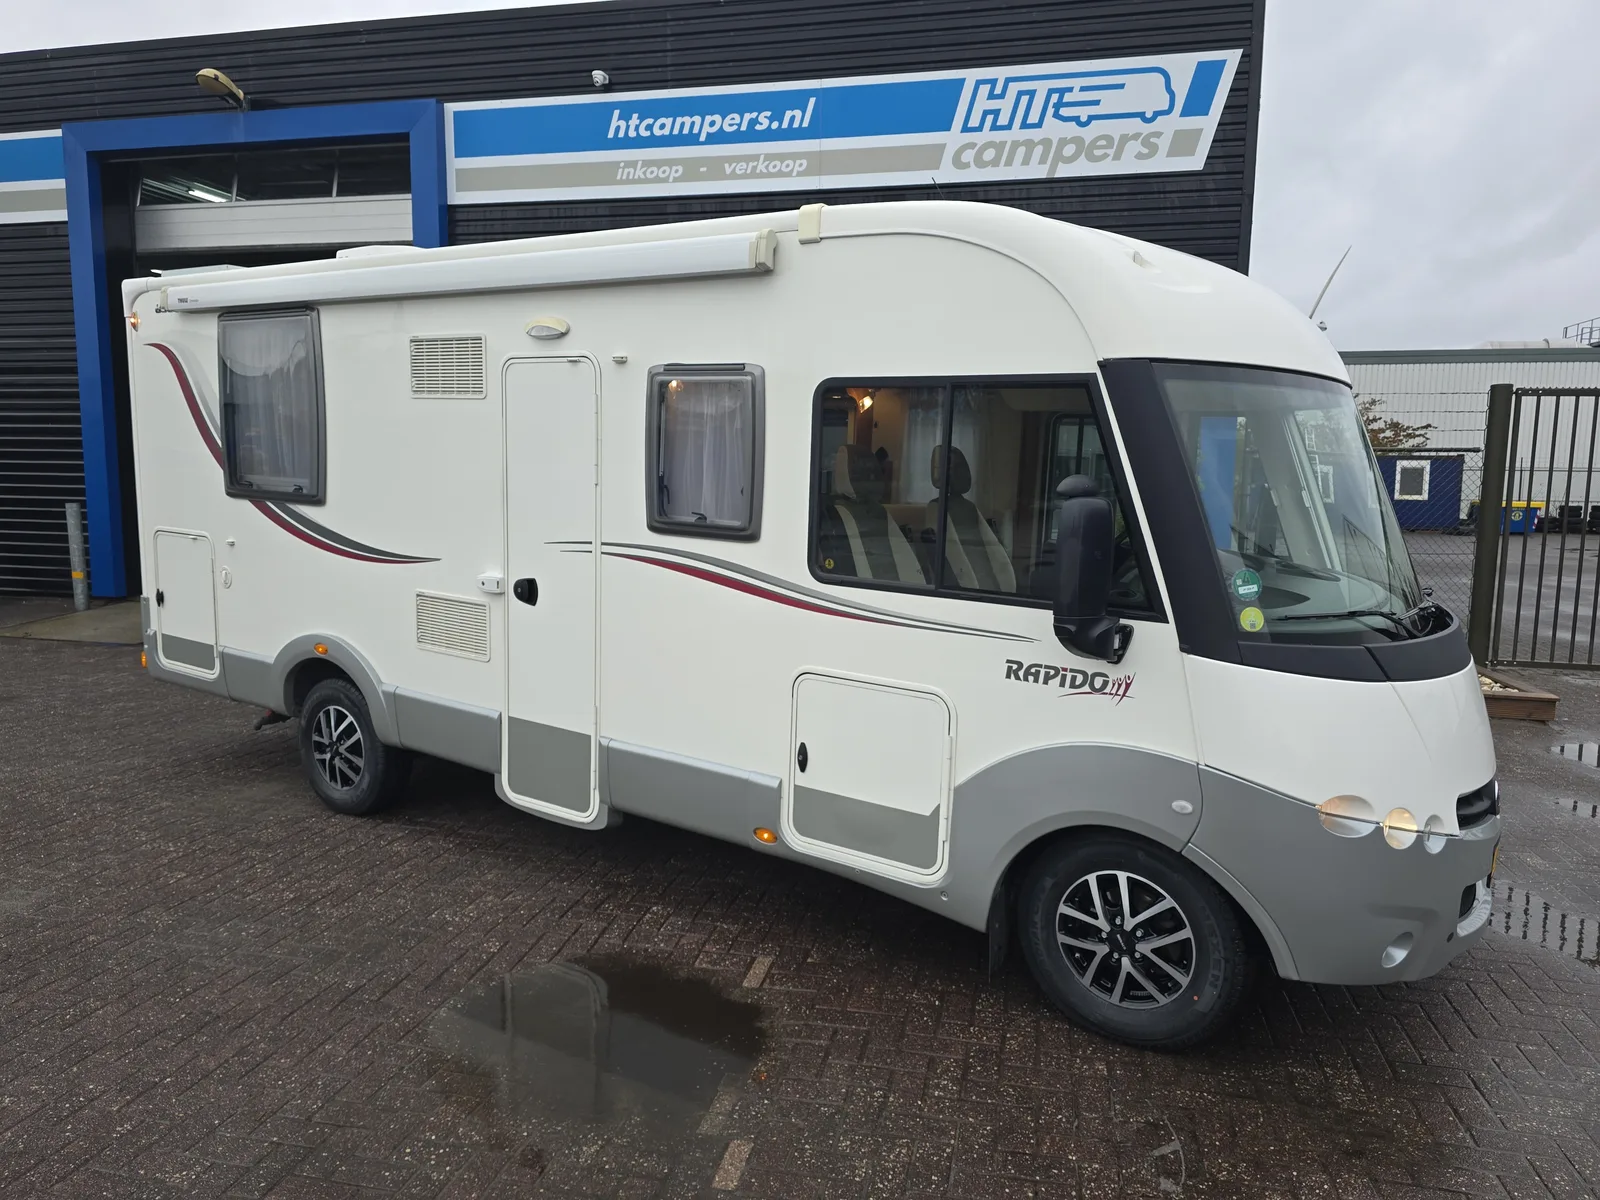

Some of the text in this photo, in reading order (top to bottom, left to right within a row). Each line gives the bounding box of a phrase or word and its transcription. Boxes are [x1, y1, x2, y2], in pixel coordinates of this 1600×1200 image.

[607, 97, 816, 141] htcampers.nl
[616, 161, 683, 182] inkoop
[724, 155, 807, 176] verkoop
[951, 130, 1164, 178] campers
